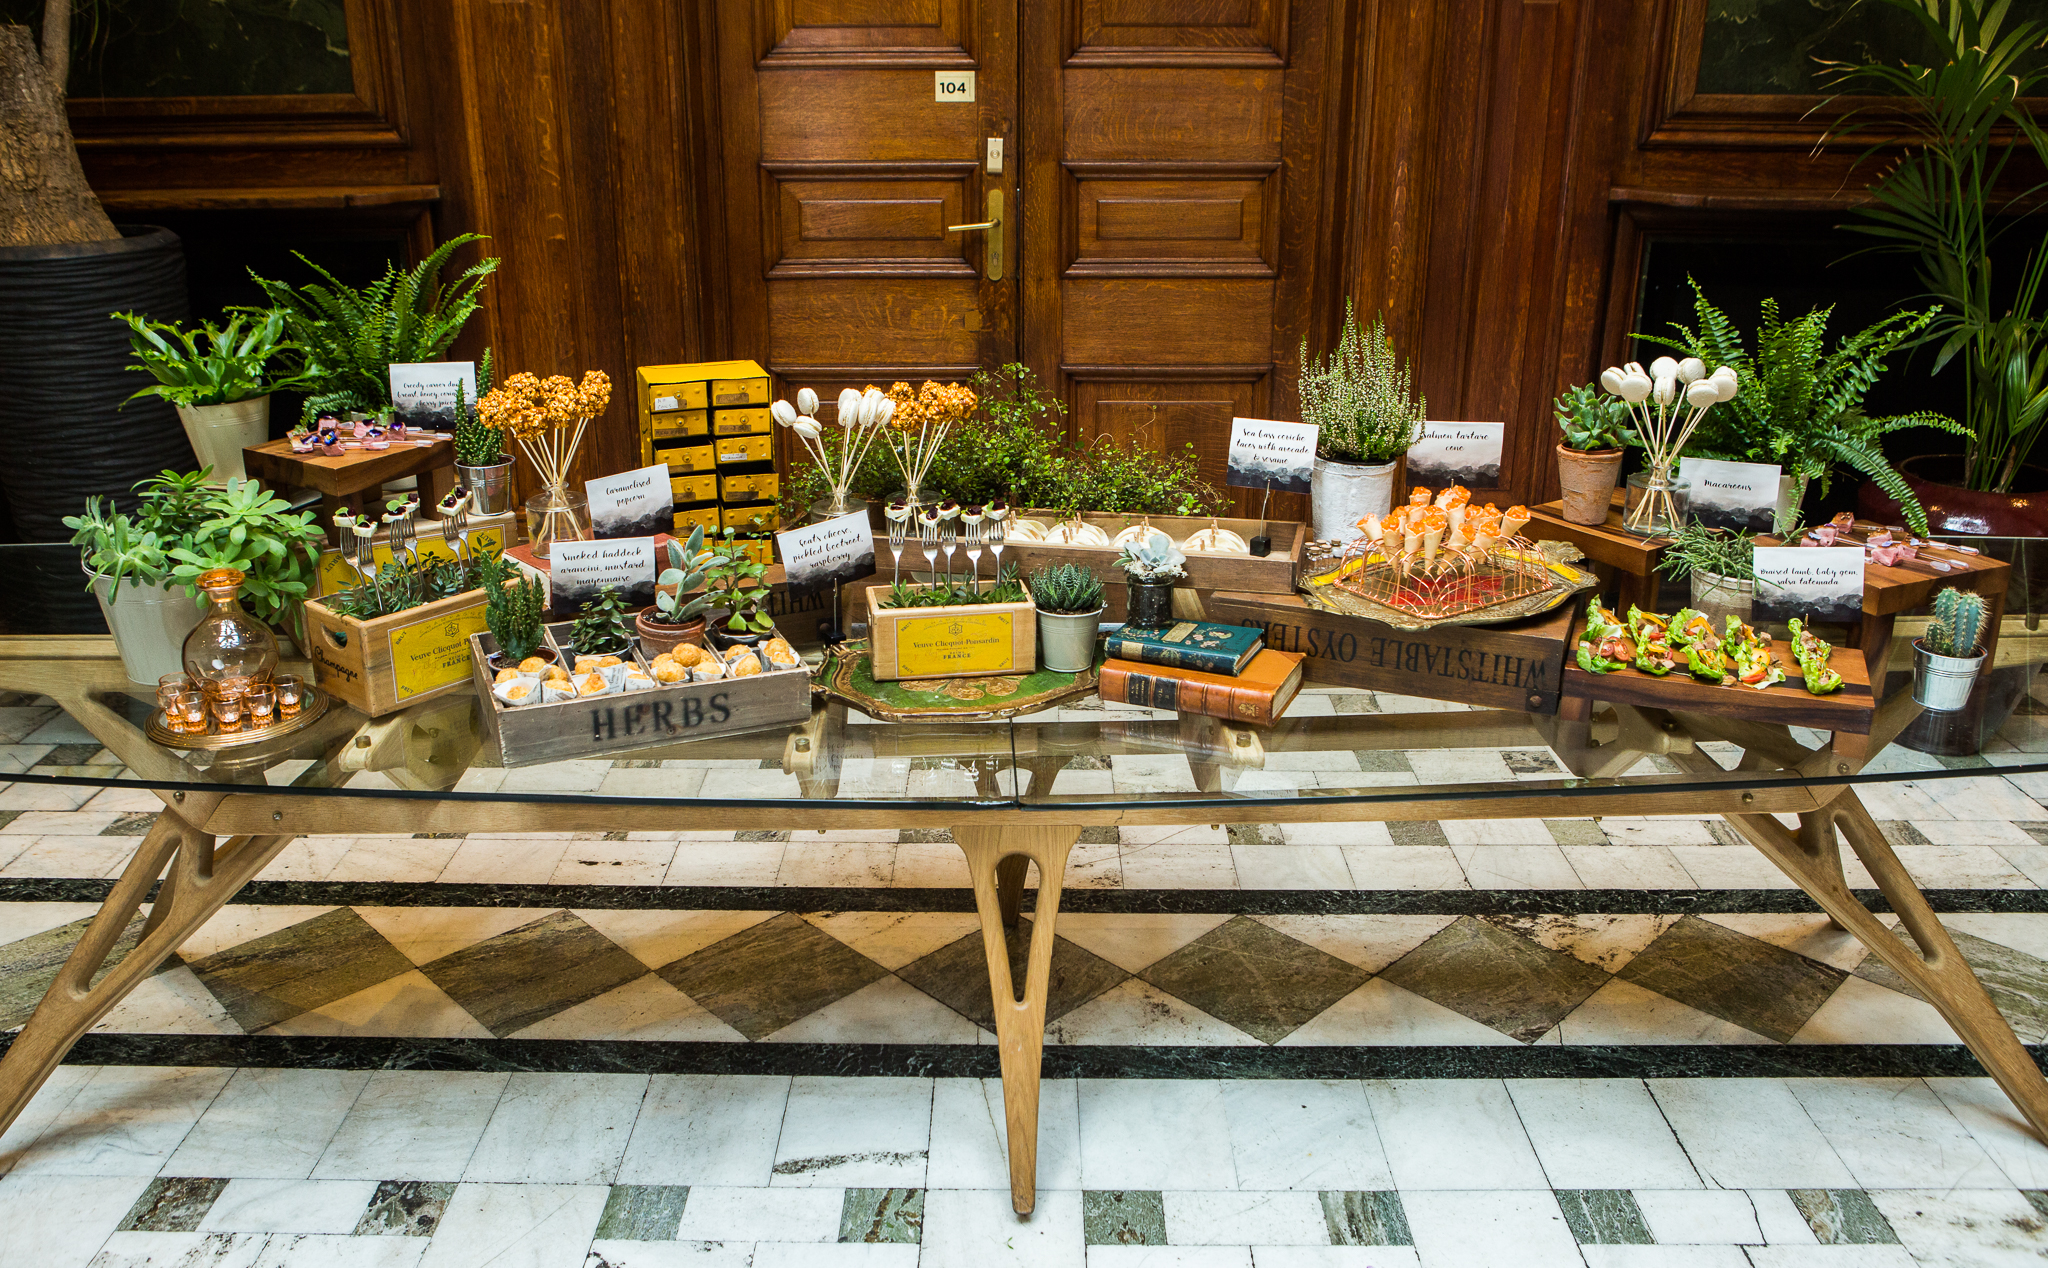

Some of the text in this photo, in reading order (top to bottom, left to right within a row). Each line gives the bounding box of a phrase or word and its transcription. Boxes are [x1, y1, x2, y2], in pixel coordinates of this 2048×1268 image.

[940, 82, 967, 94] 104
[1243, 428, 1306, 441] Sea bass ceviche
[1456, 430, 1489, 440] tartare
[1236, 439, 1310, 454] tacos with avocado
[1261, 456, 1289, 464] sesame
[605, 477, 651, 495] Caramelised
[1704, 479, 1752, 491] Macaroons
[616, 494, 645, 507] popcorn
[799, 527, 853, 547] Goats cheese,
[562, 547, 641, 561] Smoked haddock
[792, 533, 863, 563] pickled beetroot,
[560, 560, 645, 574] arancini, mustard
[810, 553, 851, 568] raspberry
[1760, 567, 1789, 575] Braised
[1791, 567, 1814, 576] lamb,
[1816, 567, 1837, 578] baby
[1777, 577, 1839, 585] salsa tatemada
[901, 621, 912, 632] BRUT
[395, 631, 407, 645] BRUT
[410, 651, 431, 662] Veuve
[433, 641, 462, 655] Clicquot
[315, 645, 358, 683] Champagne
[443, 655, 471, 668] FRANCE
[1370, 637, 1547, 690] WHITSTABLE
[902, 664, 914, 674] BRUT
[400, 685, 414, 695] BRUT
[591, 693, 731, 742] HERBS
